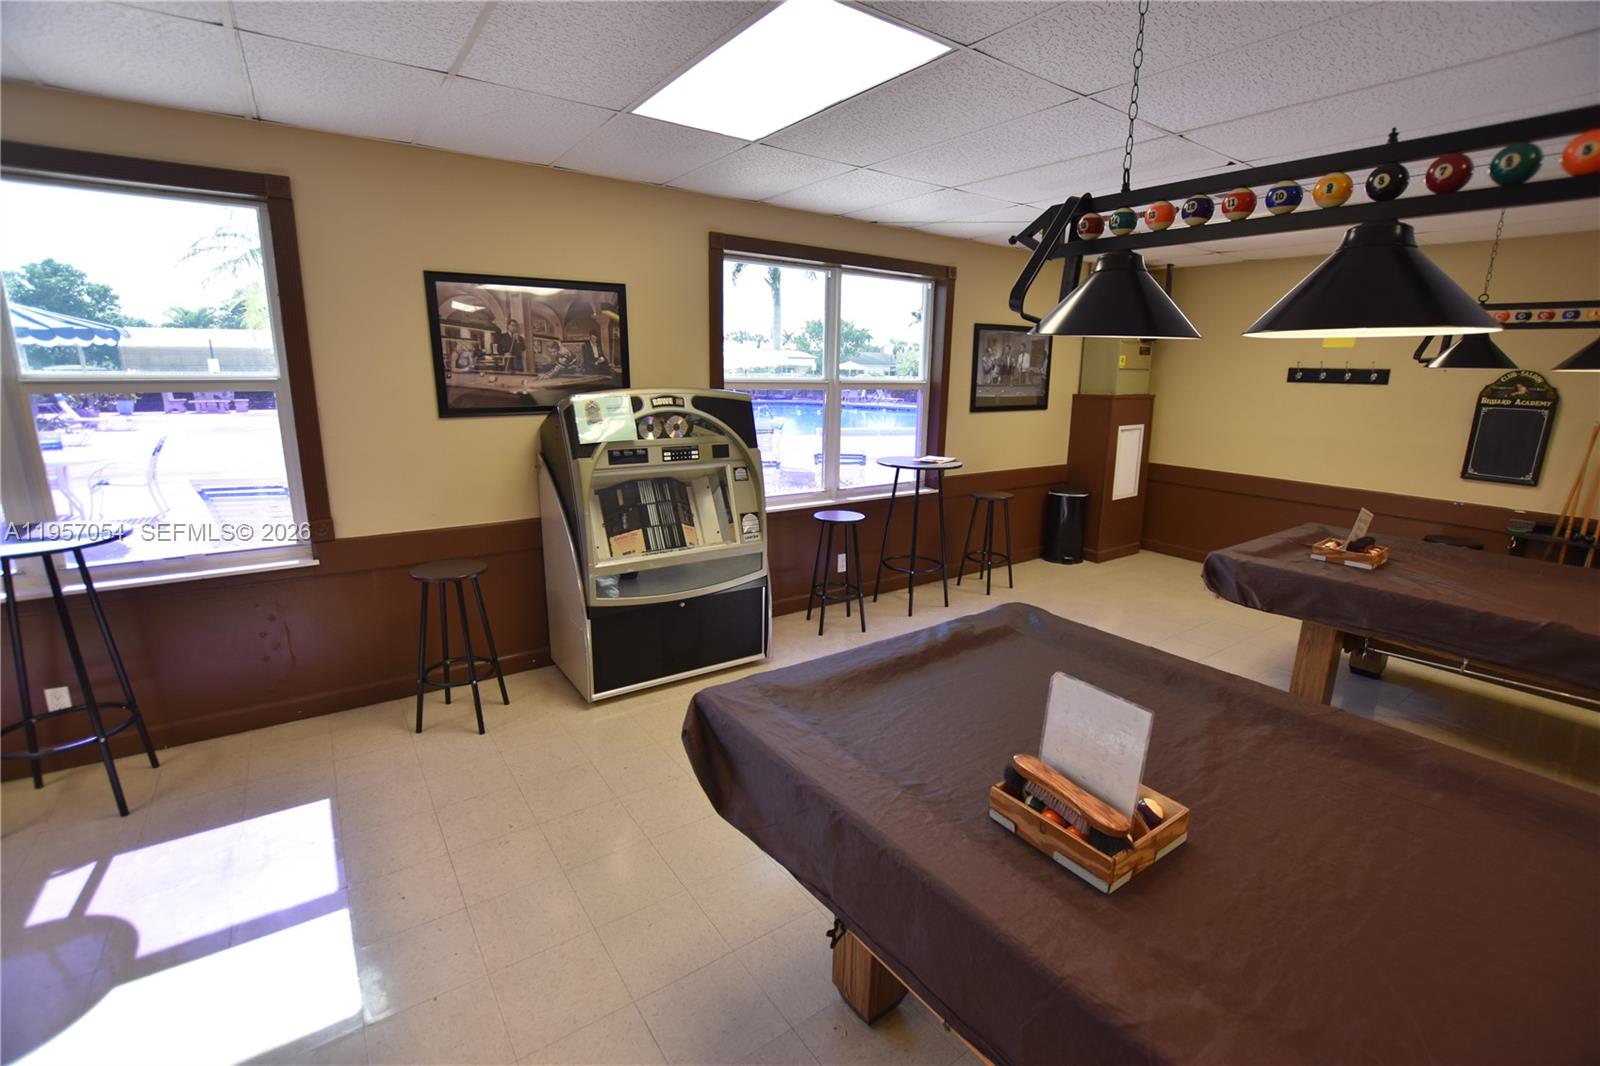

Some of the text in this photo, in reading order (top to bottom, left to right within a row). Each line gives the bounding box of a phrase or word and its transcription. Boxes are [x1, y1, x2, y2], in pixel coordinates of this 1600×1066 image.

[1275, 192, 1285, 201] 10
[1227, 199, 1236, 207] 11
[1514, 399, 1552, 407] ACADEMY
